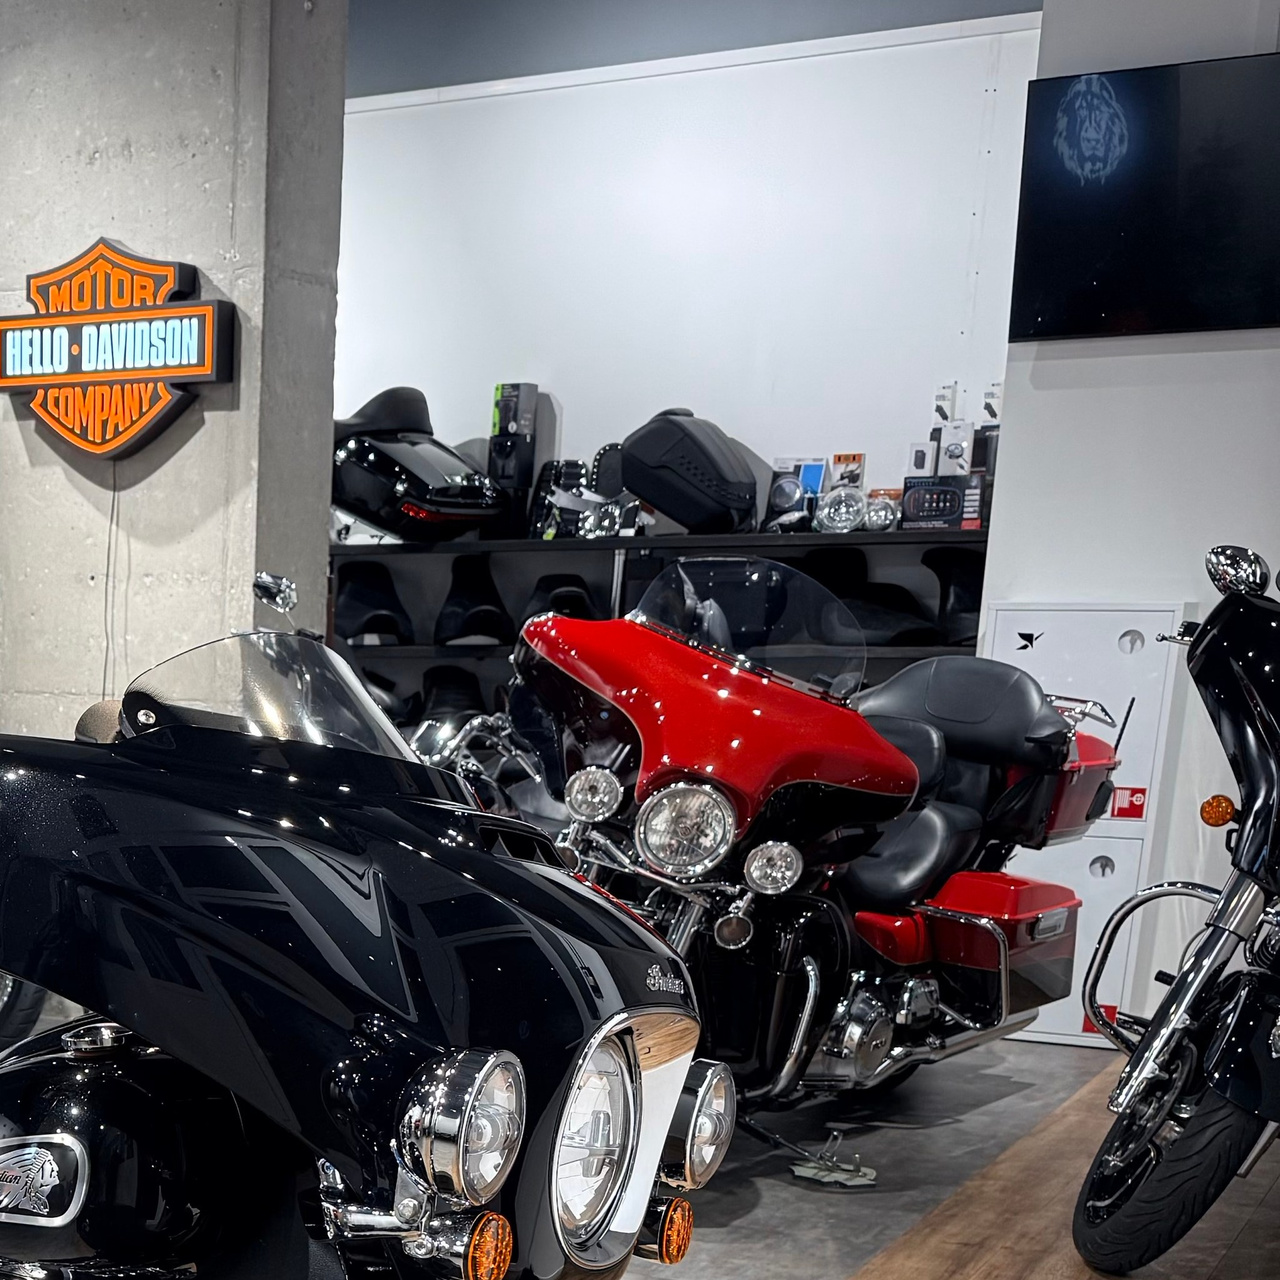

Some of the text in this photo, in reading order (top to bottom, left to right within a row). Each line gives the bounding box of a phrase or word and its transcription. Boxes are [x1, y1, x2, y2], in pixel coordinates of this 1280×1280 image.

[49, 259, 155, 314] MOTOR
[6, 317, 199, 376] HELLO DAVIDSON
[47, 382, 155, 443] COMPANY
